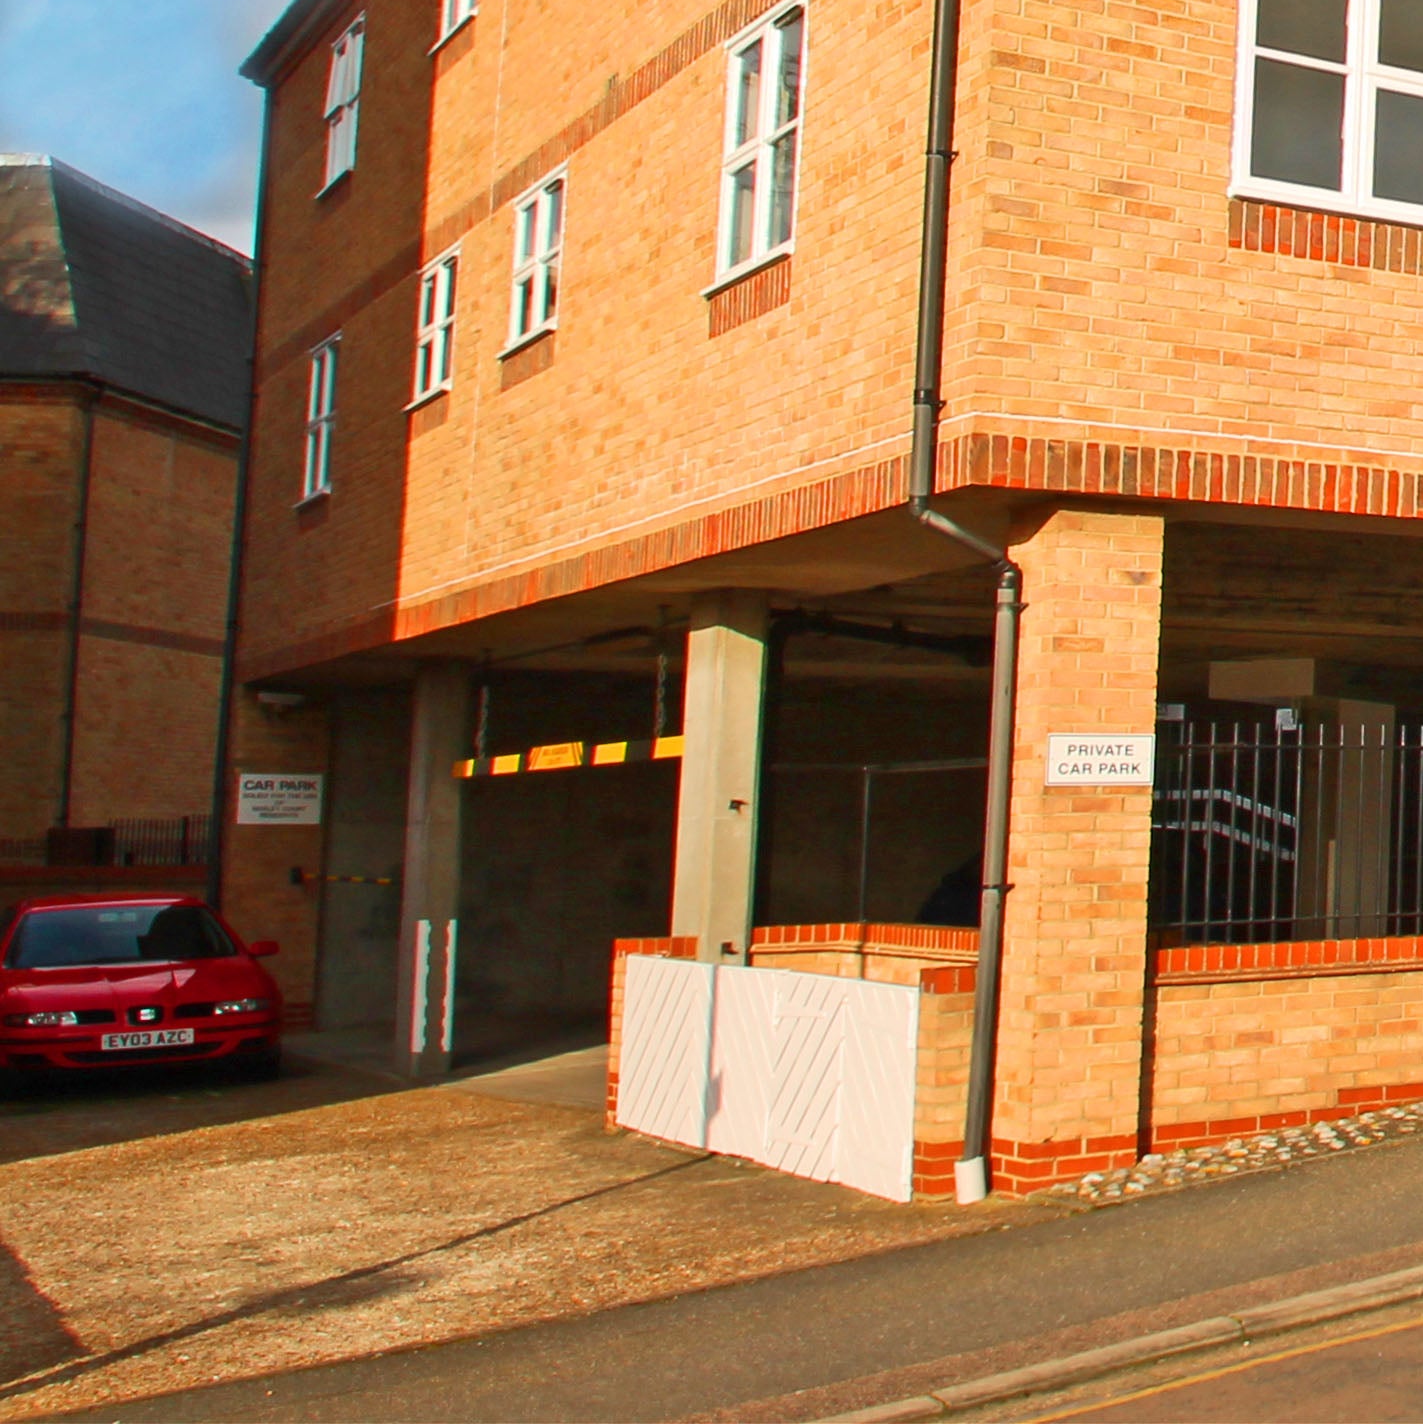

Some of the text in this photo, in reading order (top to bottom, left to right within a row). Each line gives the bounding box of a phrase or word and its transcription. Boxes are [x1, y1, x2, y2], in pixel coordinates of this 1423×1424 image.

[1067, 744, 1134, 756] PRIVATE
[1058, 762, 1141, 775] CAR PARK
[244, 780, 317, 791] CAR PARK
[108, 1030, 187, 1048] EY03 AZC
